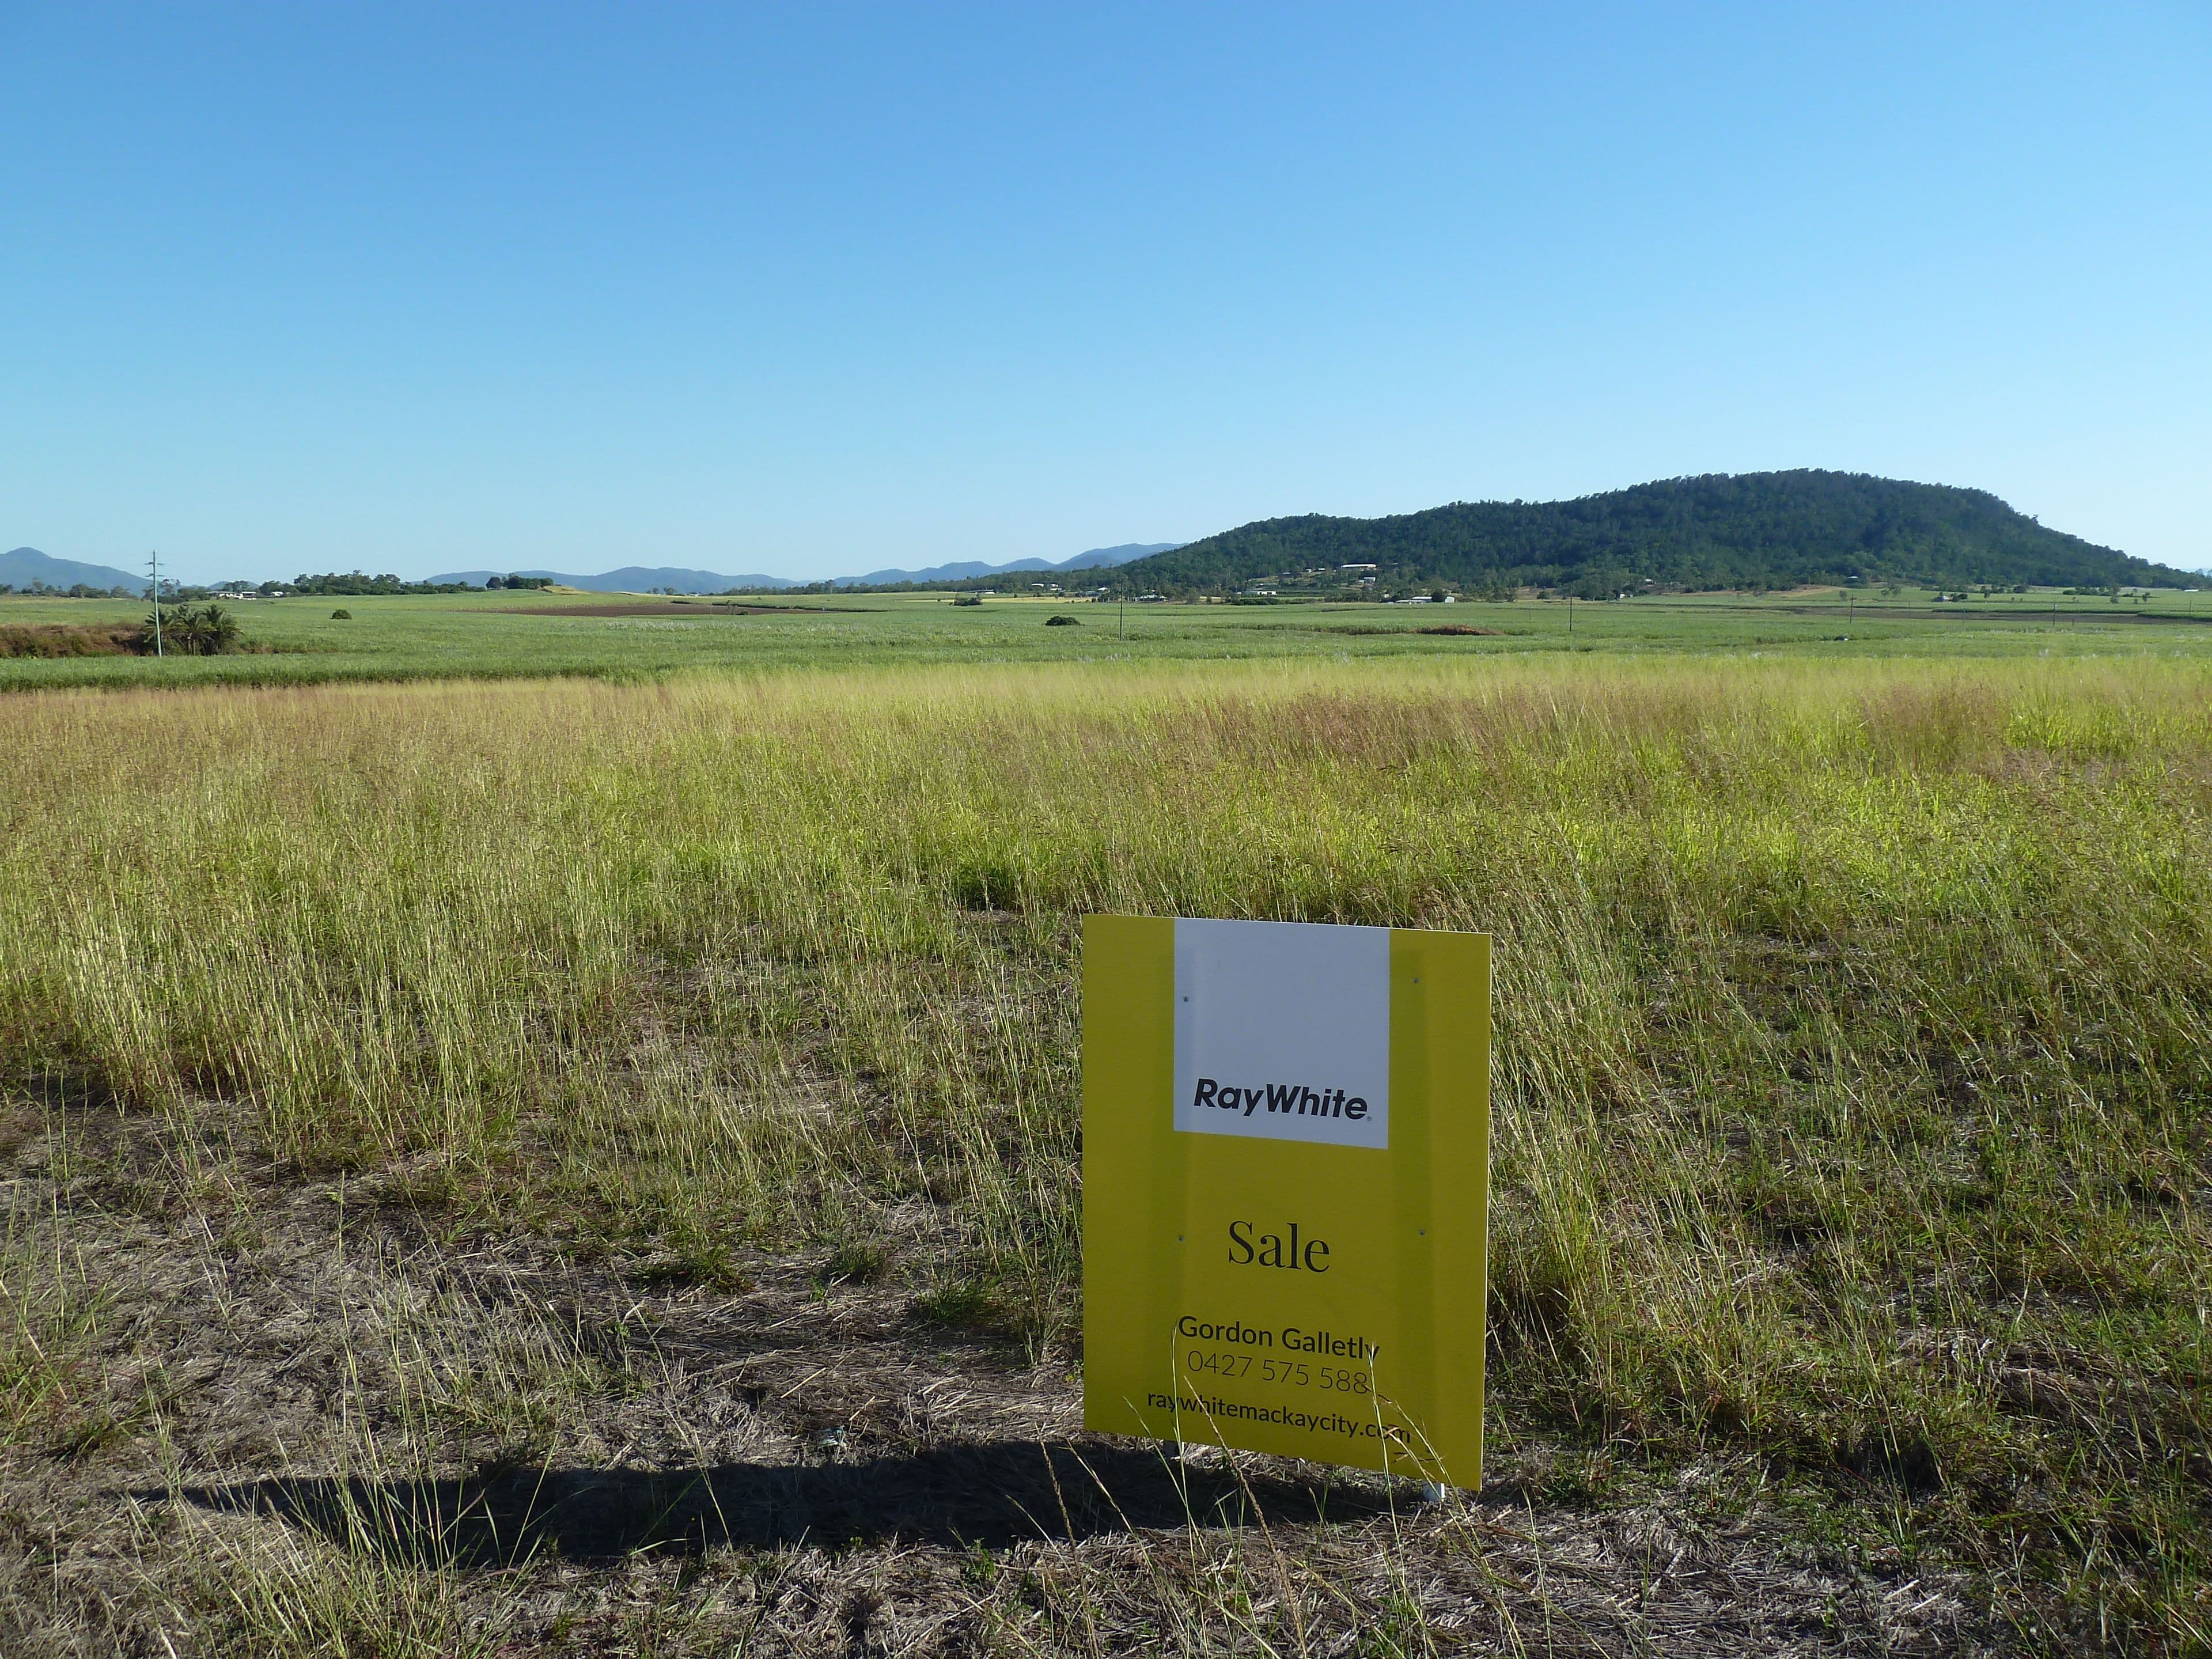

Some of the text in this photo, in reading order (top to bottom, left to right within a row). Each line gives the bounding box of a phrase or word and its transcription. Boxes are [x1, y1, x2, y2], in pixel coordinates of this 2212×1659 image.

[1228, 1220, 1330, 1273] Sale
[1179, 1316, 1272, 1347] Gordon
[1188, 1351, 1368, 1394] 0427 575 588
